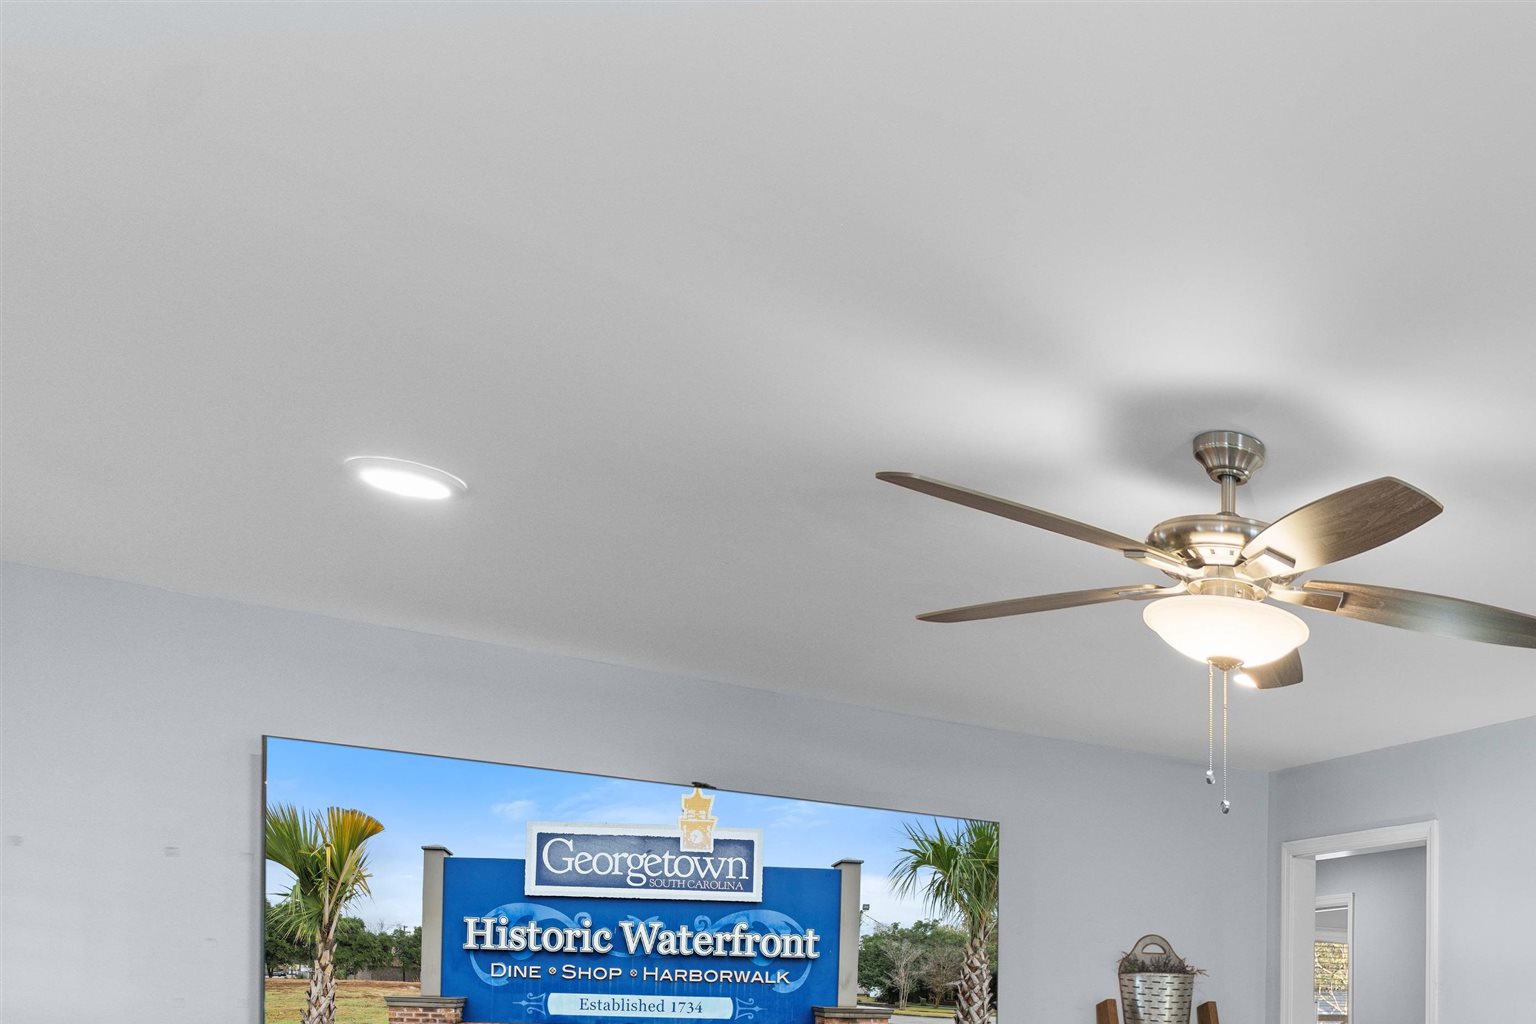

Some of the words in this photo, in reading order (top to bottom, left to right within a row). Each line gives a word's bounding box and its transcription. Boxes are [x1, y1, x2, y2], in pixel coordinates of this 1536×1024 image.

[542, 837, 749, 887] Georgetown
[649, 878, 685, 889] SOUTH
[687, 879, 744, 891] CAROLINA
[463, 916, 613, 954] Historic
[619, 920, 820, 959] Waterfront
[579, 997, 665, 1013] Established
[671, 1001, 703, 1014] 1734
